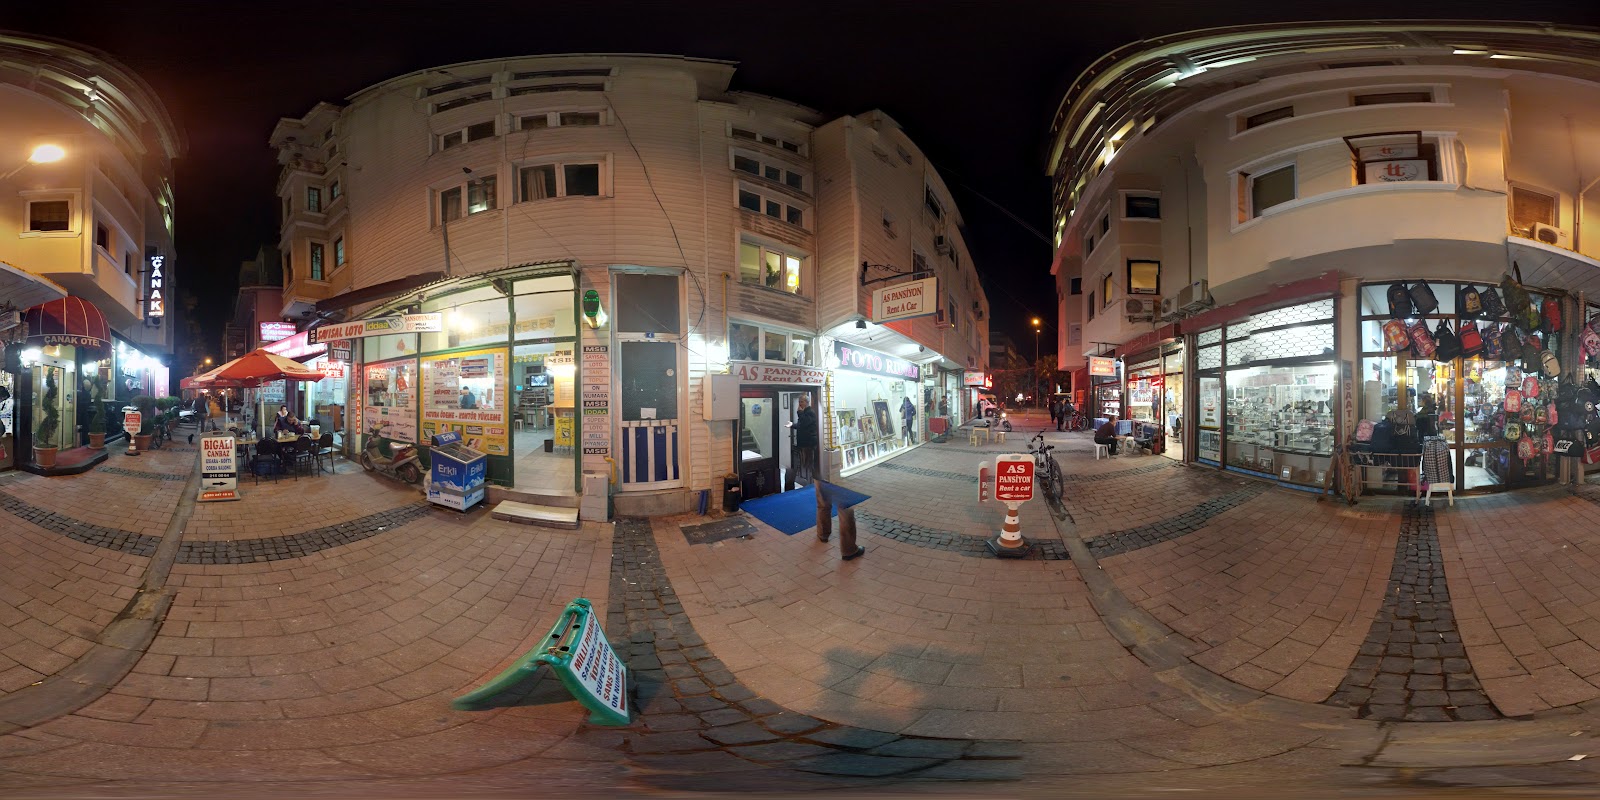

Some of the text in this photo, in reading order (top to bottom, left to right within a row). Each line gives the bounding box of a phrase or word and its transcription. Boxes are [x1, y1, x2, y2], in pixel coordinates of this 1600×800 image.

[883, 287, 922, 303] AS PANSİYON
[887, 302, 917, 314] Rent A Car
[318, 324, 363, 340] SAYISAL LOTO
[367, 322, 388, 330] iddaa
[80, 338, 101, 347] OTEL
[333, 340, 350, 349] SPOR
[334, 350, 350, 359] TOTO
[841, 347, 882, 371] FOTO
[739, 365, 825, 381] AS PANSİYON
[440, 410, 455, 418] ÖDEME
[459, 411, 477, 420] KONTÖR
[478, 412, 502, 421] YÜKLEME
[1007, 465, 1026, 473] AS
[574, 642, 588, 671] MİLLİ
[581, 644, 596, 681] SAYISAL
[590, 642, 604, 682] İDDAA
[596, 663, 606, 695] SÜPER
[612, 697, 618, 708] ON
